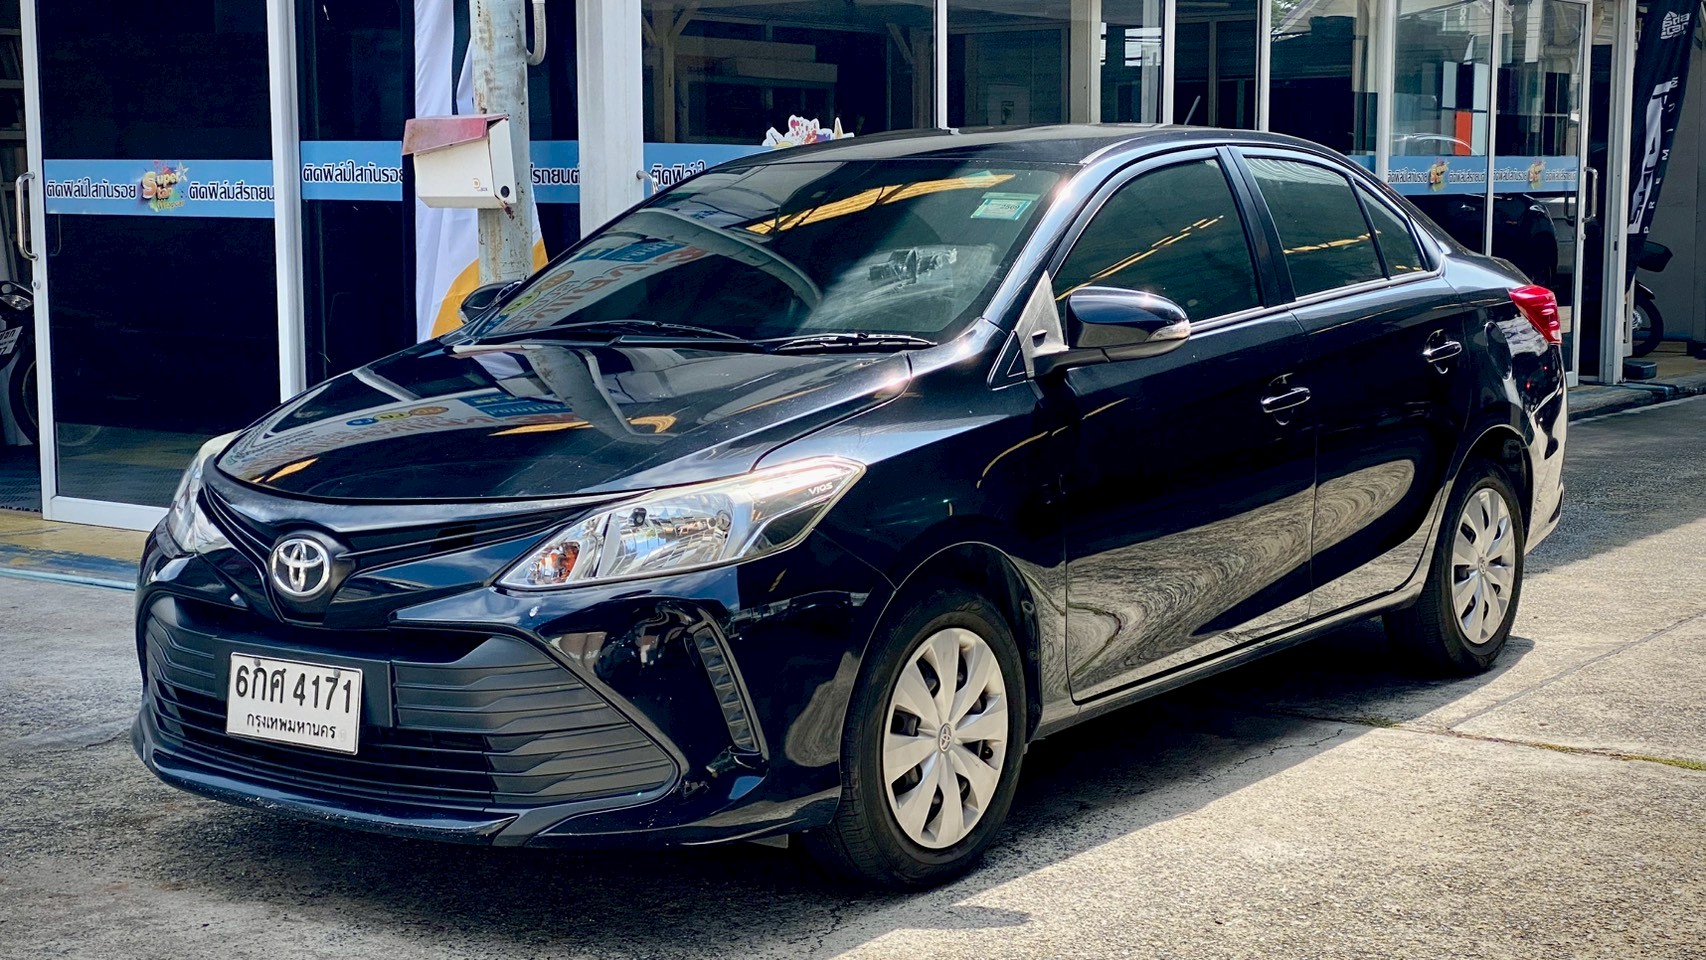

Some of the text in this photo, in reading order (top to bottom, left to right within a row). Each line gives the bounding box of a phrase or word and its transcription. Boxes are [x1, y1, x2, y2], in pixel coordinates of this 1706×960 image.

[46, 177, 136, 199] ติดฟิล์มใสกันรอย
[808, 482, 834, 495] VIOS
[236, 665, 351, 713] 6กศ 4171
[247, 713, 336, 739] กรุงเทพมหานคร
